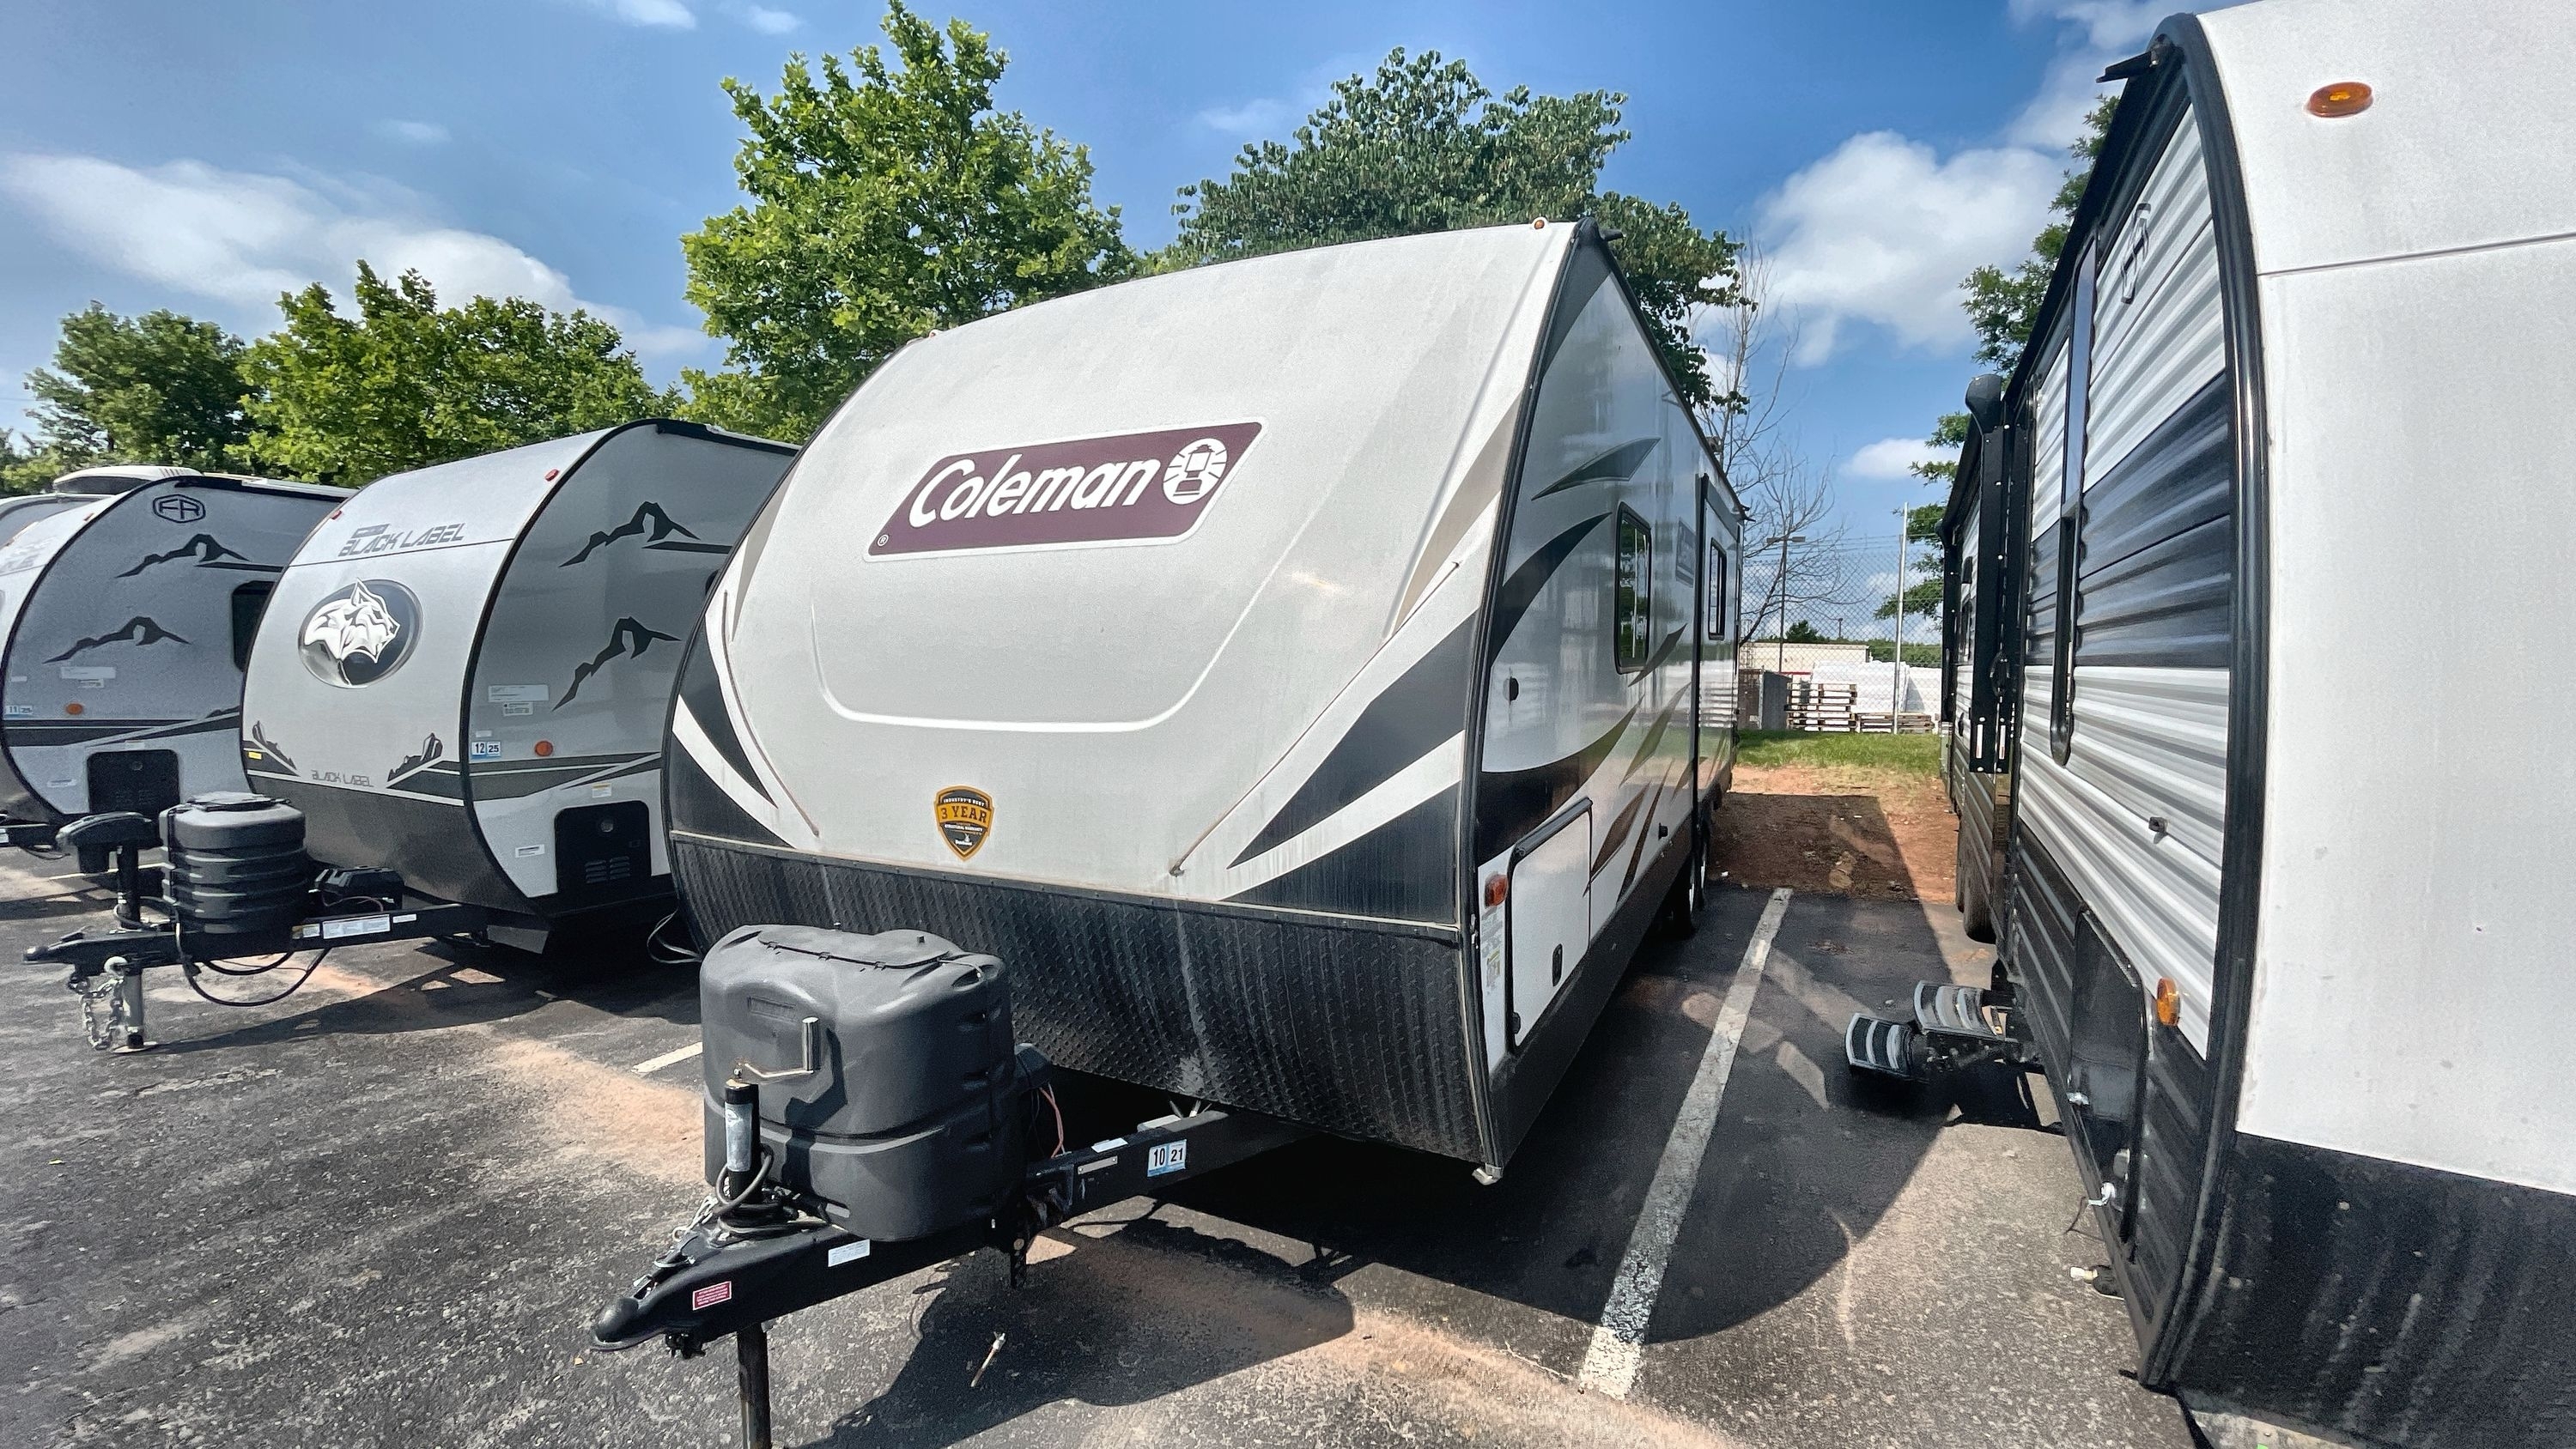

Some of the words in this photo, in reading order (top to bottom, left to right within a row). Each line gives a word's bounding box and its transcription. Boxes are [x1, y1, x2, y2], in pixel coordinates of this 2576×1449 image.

[908, 453, 1161, 528] Coleman
[337, 531, 404, 556] BLACK
[399, 523, 465, 549] LABEL
[475, 743, 485, 754] 12
[488, 744, 500, 753] 25
[940, 808, 948, 820] 3
[951, 806, 987, 823] YEAR
[1153, 1148, 1166, 1167] 10
[1170, 1148, 1184, 1162] 21
